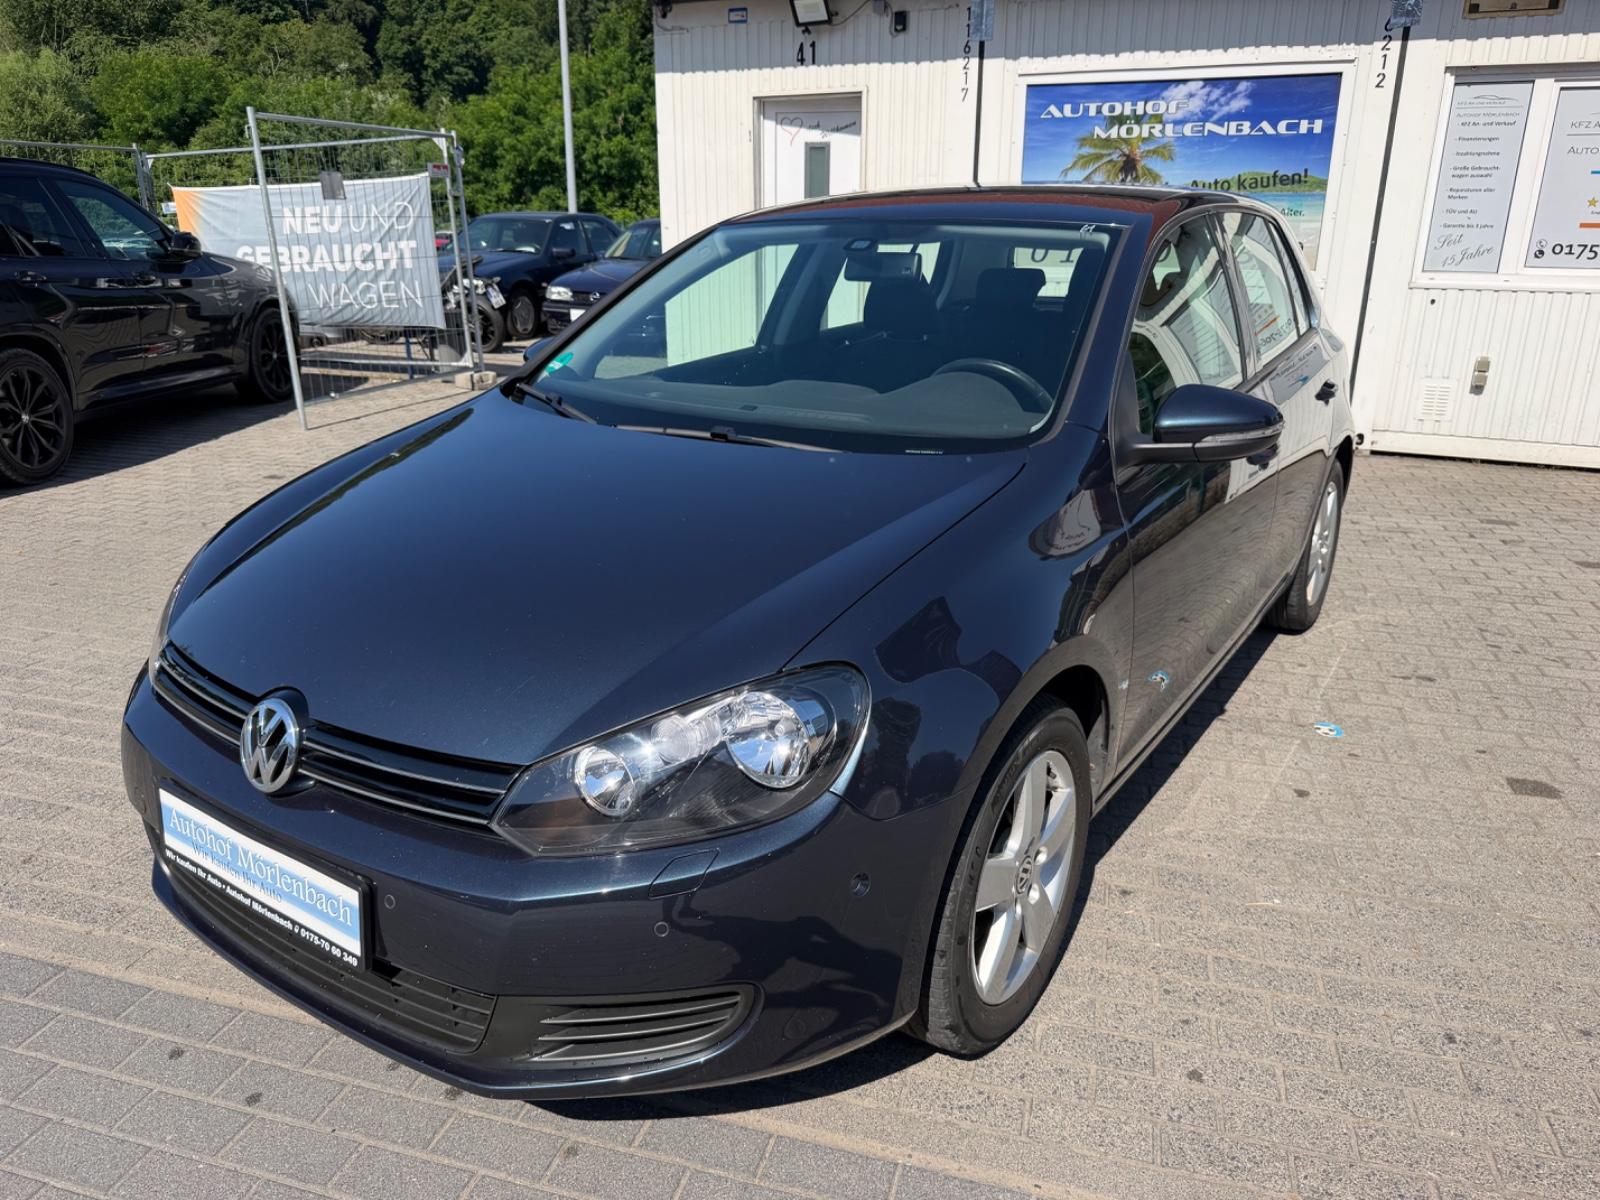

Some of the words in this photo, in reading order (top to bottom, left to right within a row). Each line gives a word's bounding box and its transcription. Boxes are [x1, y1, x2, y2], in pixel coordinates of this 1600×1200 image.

[796, 40, 816, 66] 41
[1040, 100, 1191, 119] AUTOHOF
[1093, 119, 1323, 139] MÖRLENBACH
[1570, 120, 1592, 129] KFZ
[1237, 168, 1309, 191] kaufen!
[282, 206, 342, 235] NEU
[349, 201, 415, 233] UND
[236, 240, 417, 272] GEBRAUCHT
[1455, 243, 1494, 266] Jahre
[308, 281, 424, 309] WAGEN
[170, 808, 233, 861] Autohof
[238, 845, 353, 927] Mörlenbach
[207, 874, 223, 889] Auto
[226, 886, 251, 907] Autohof
[251, 901, 293, 931] Mörlenbach
[300, 928, 331, 952] 0175-70
